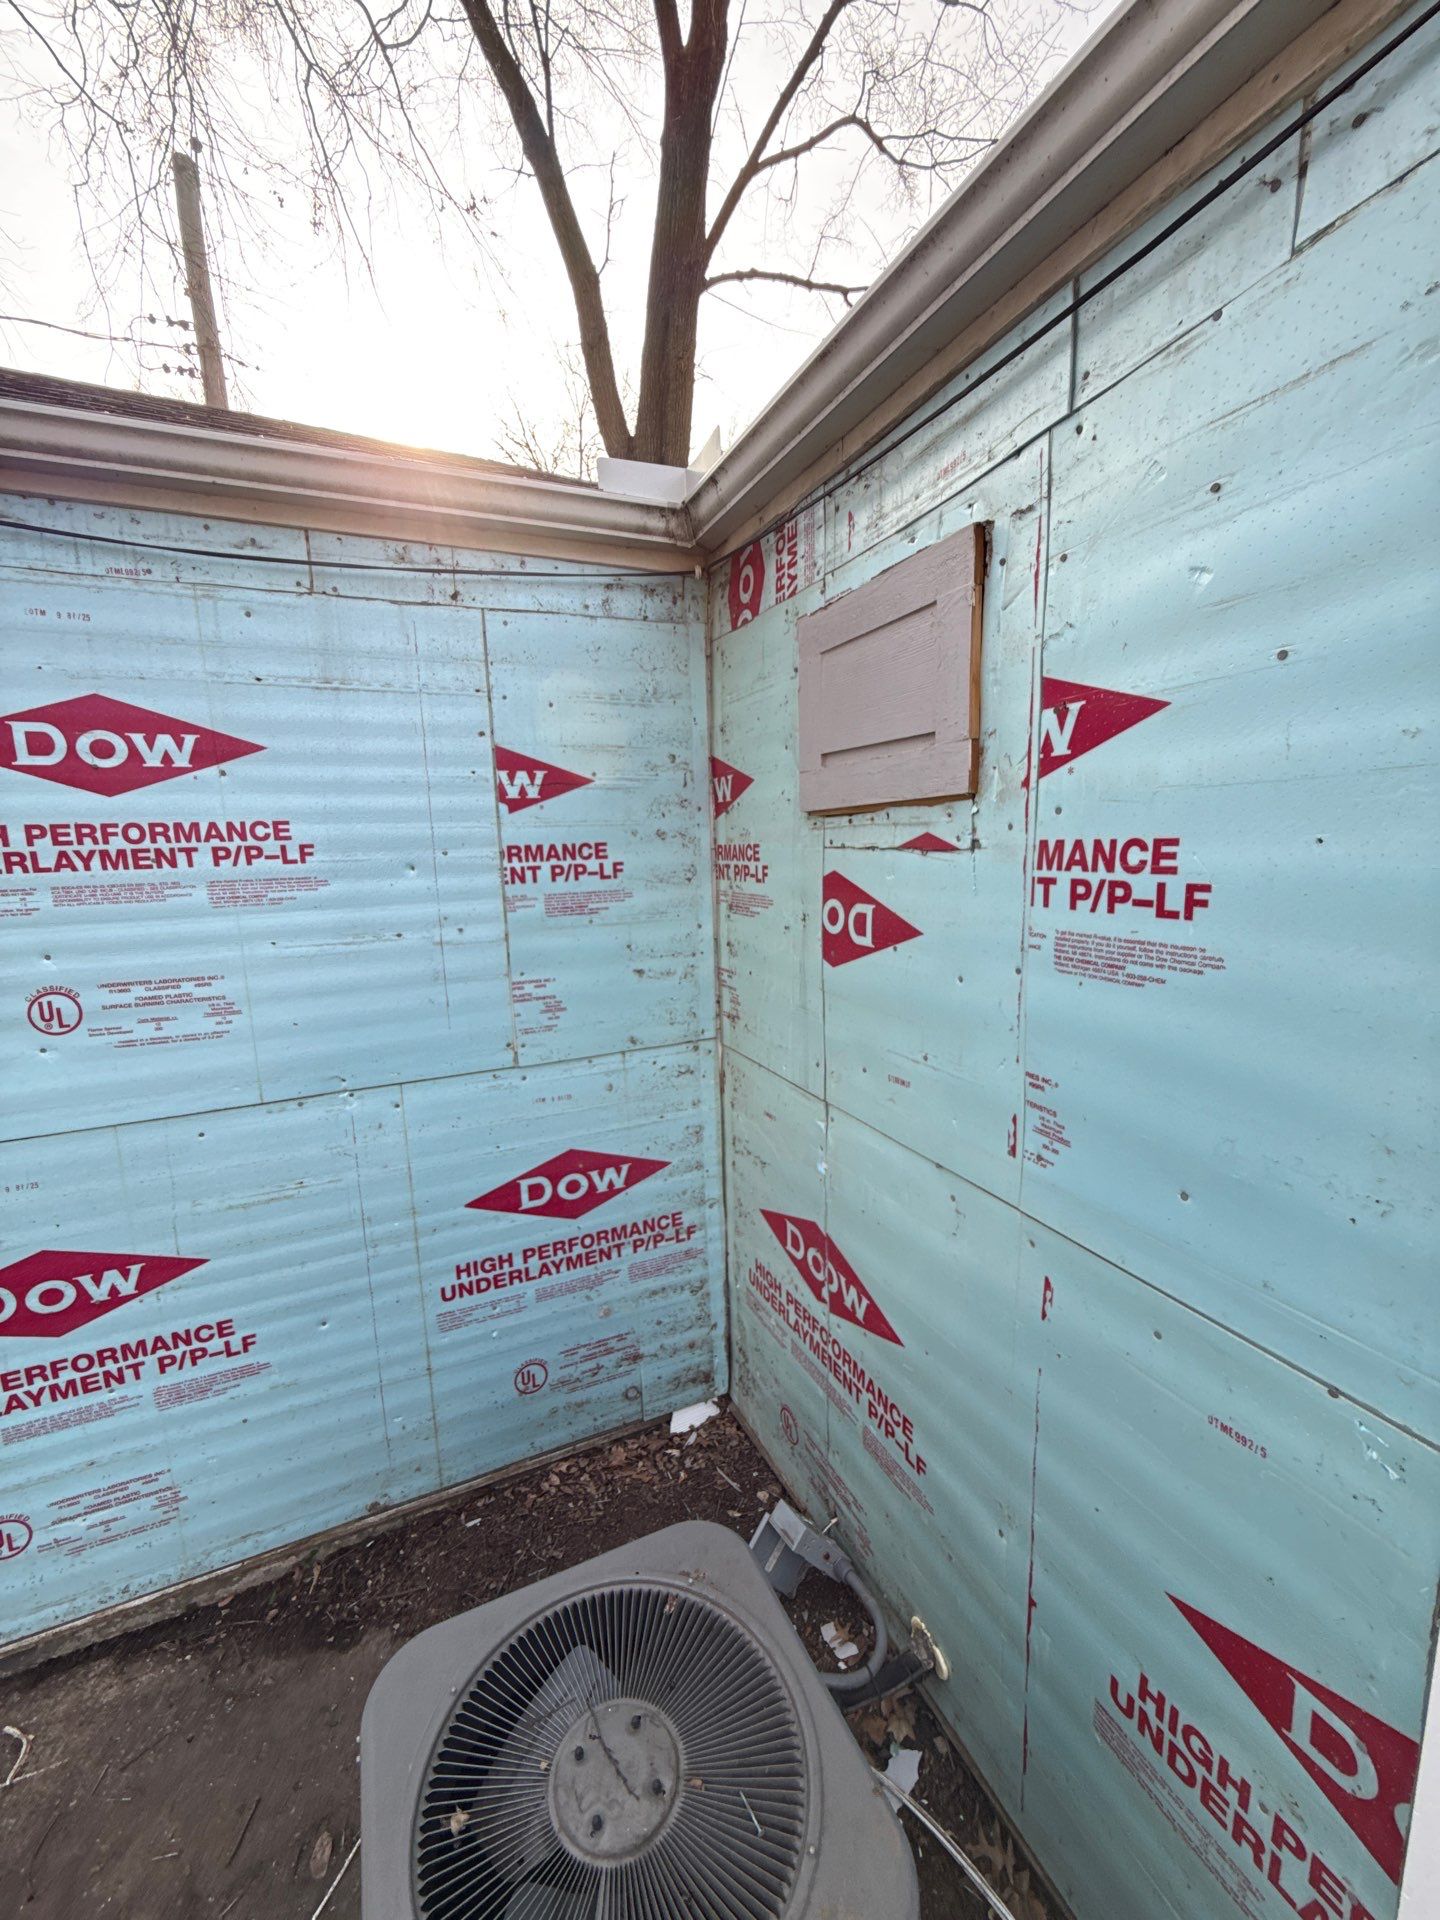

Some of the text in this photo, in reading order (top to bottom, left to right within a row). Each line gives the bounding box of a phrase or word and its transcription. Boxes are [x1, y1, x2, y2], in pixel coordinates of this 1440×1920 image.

[5, 720, 200, 768] DOW
[24, 820, 292, 847] PERFORMANCE
[502, 841, 609, 863] RMANCE
[0, 847, 198, 875] RLAYMENT
[38, 1000, 71, 1030] UL
[516, 1163, 633, 1211] DOW
[455, 1211, 684, 1280] HIGH PERFORMANCE
[440, 1242, 625, 1303] UNDERLAYMENT
[755, 1258, 782, 1298] HIGH
[1138, 1672, 1251, 1815] HIGH
